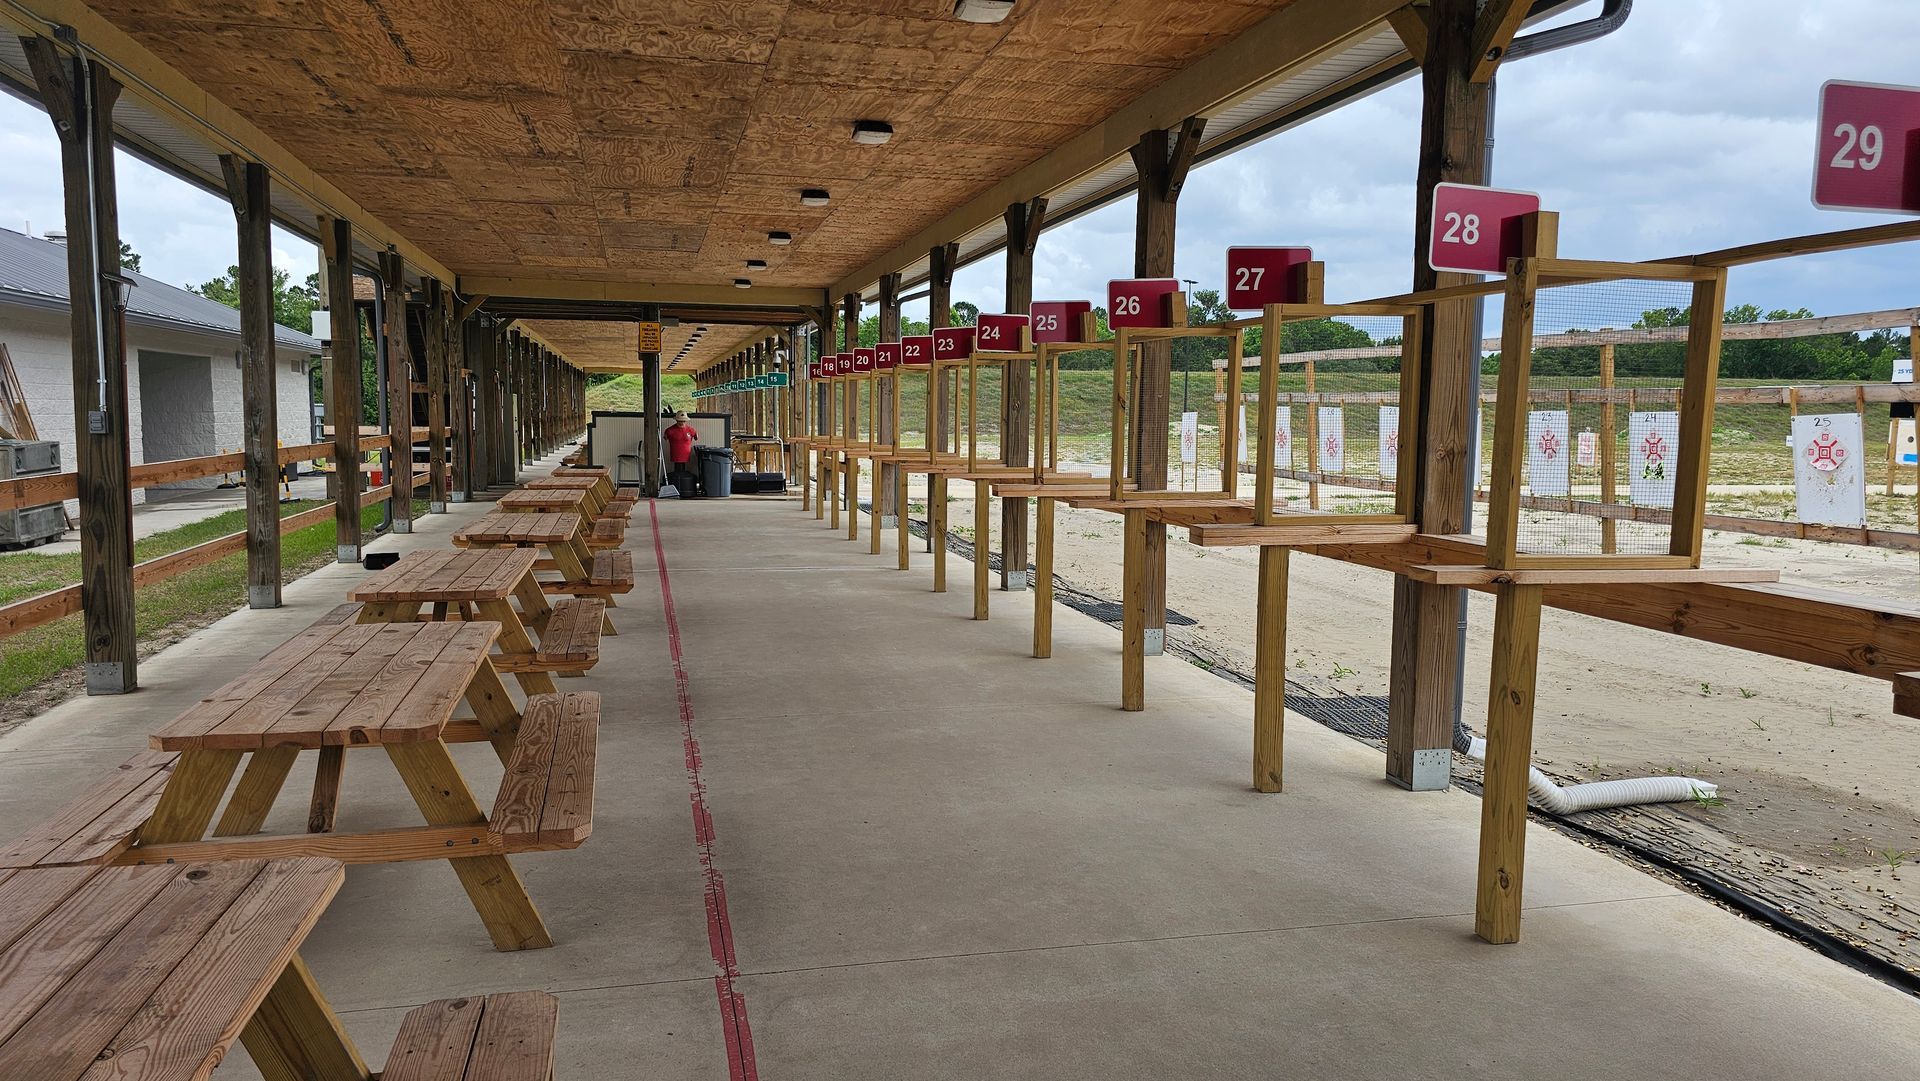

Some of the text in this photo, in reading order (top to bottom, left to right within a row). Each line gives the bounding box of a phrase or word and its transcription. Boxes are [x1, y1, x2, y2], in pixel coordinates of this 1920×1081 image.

[1830, 123, 1883, 171] 29
[1441, 211, 1481, 246] 28
[1235, 266, 1265, 292] 27
[1114, 294, 1141, 316] 26
[1035, 314, 1058, 331] 25
[981, 325, 1001, 341] 24
[937, 338, 955, 351] 23
[878, 351, 891, 362] 21
[905, 345, 921, 357] 22
[839, 359, 850, 369] 19
[856, 355, 869, 365] 20
[823, 362, 834, 371] 18
[1541, 412, 1553, 422] 23
[1644, 413, 1657, 423] 24
[1814, 417, 1832, 427] 25
